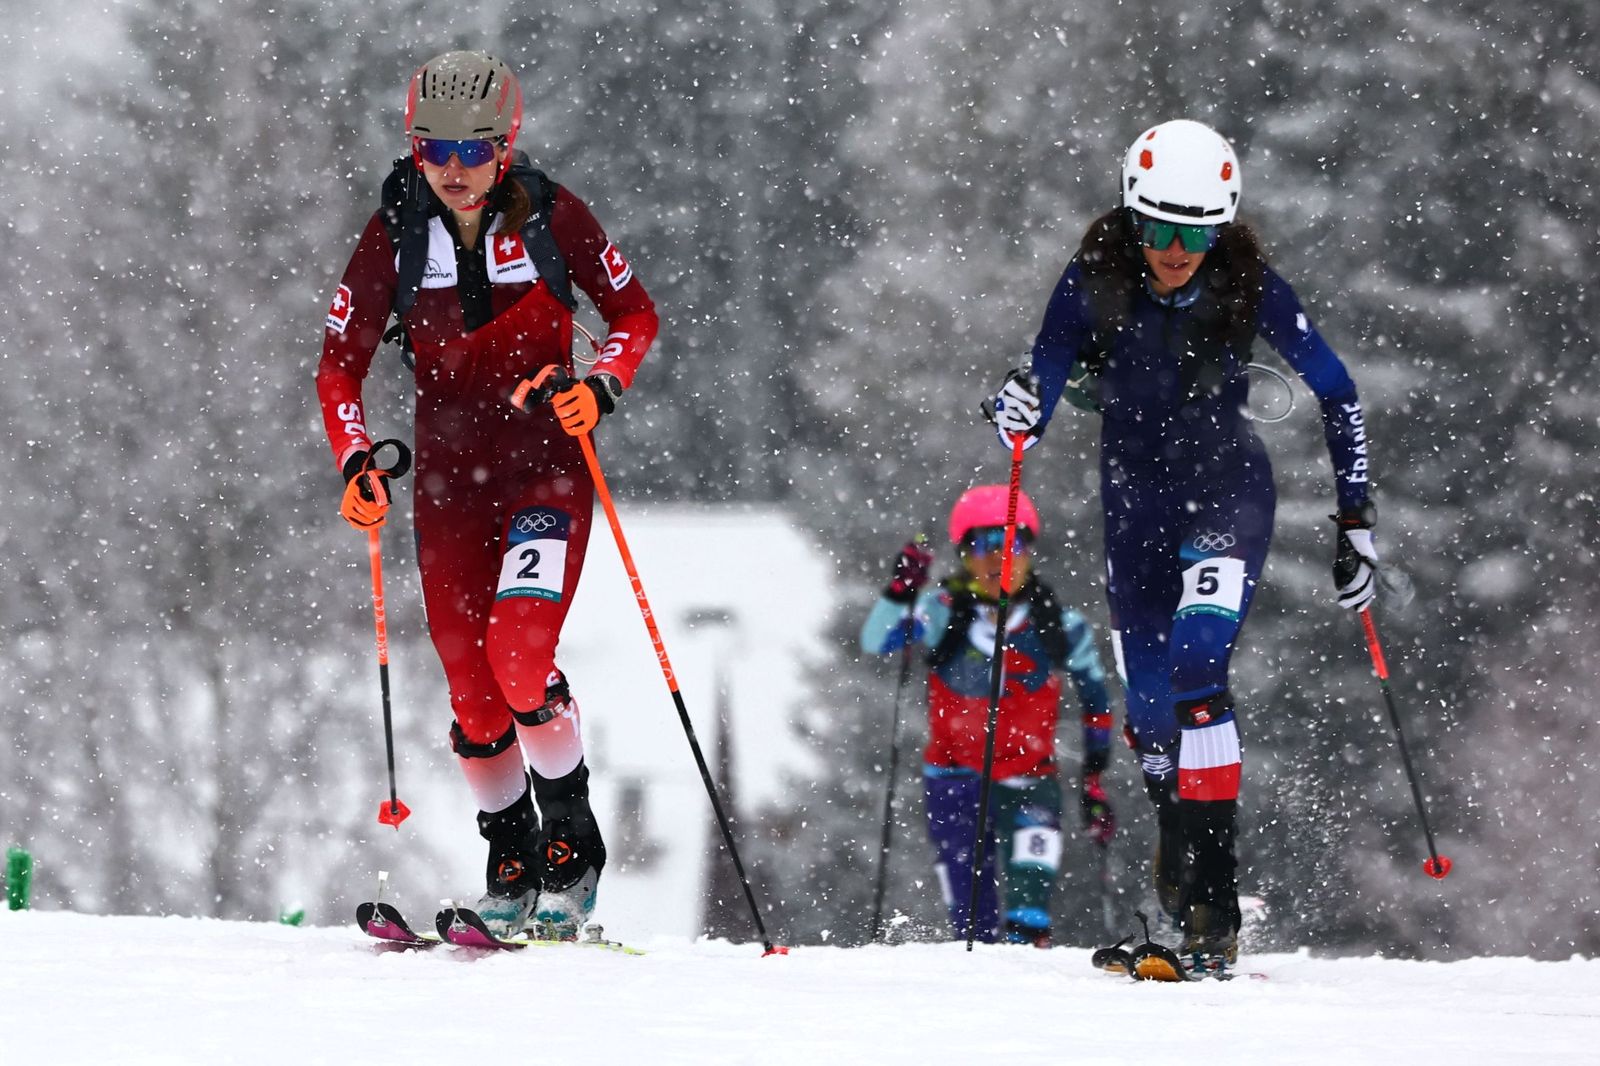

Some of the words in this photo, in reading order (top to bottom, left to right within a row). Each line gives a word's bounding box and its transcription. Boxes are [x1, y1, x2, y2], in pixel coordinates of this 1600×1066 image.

[600, 332, 631, 363] UI
[1341, 402, 1369, 484] FRANCE
[517, 548, 541, 579] 2
[1196, 566, 1219, 596] 5
[629, 576, 652, 620] WAY
[652, 633, 673, 681] ONE
